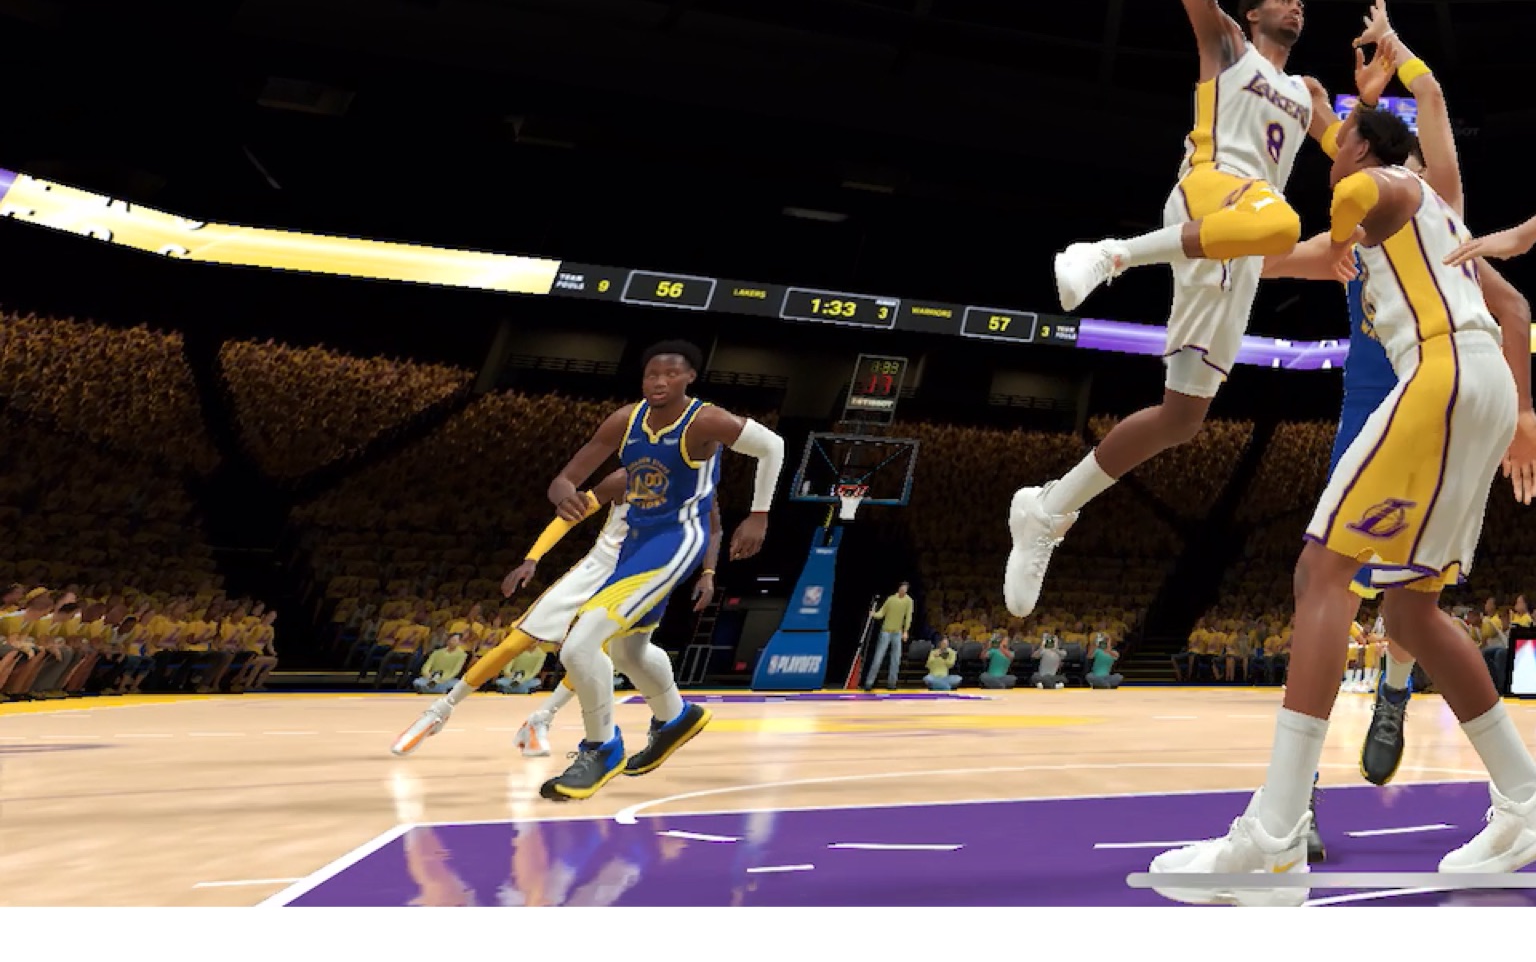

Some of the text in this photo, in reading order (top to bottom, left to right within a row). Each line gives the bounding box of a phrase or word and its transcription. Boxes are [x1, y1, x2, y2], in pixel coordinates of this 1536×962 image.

[1265, 121, 1285, 165] 8
[598, 279, 611, 293] 9
[656, 281, 684, 298] 56
[733, 288, 766, 299] LAKERS
[811, 298, 857, 317] 1:33
[877, 306, 888, 319] 3
[988, 315, 1012, 332] 57
[1041, 325, 1050, 338] 3
